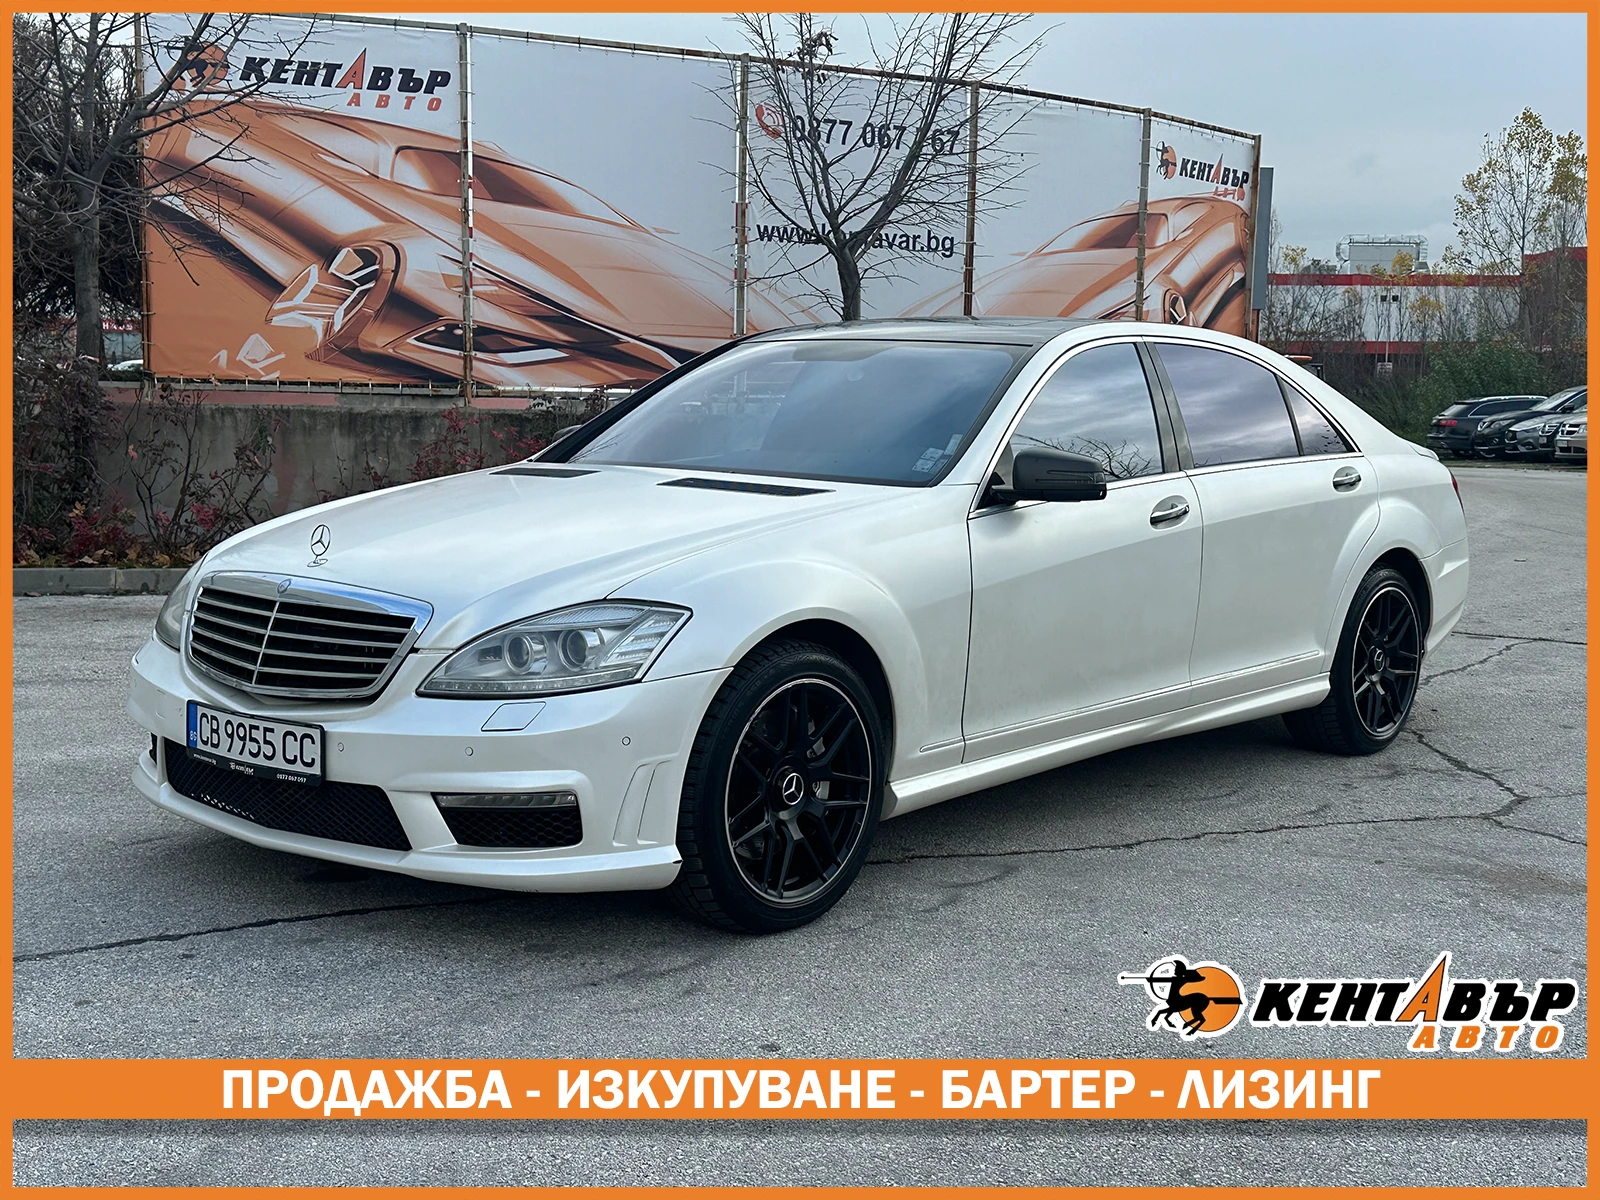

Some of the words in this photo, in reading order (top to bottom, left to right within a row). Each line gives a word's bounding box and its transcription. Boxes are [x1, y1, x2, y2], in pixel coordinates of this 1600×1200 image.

[239, 47, 451, 94] КЕНТАВЪР
[347, 92, 442, 112] АВТО
[862, 122, 907, 150] 067
[1179, 153, 1250, 187] КЕНТАВЪР
[200, 712, 221, 749] CB
[224, 719, 277, 761] 9955
[282, 730, 316, 768] CC
